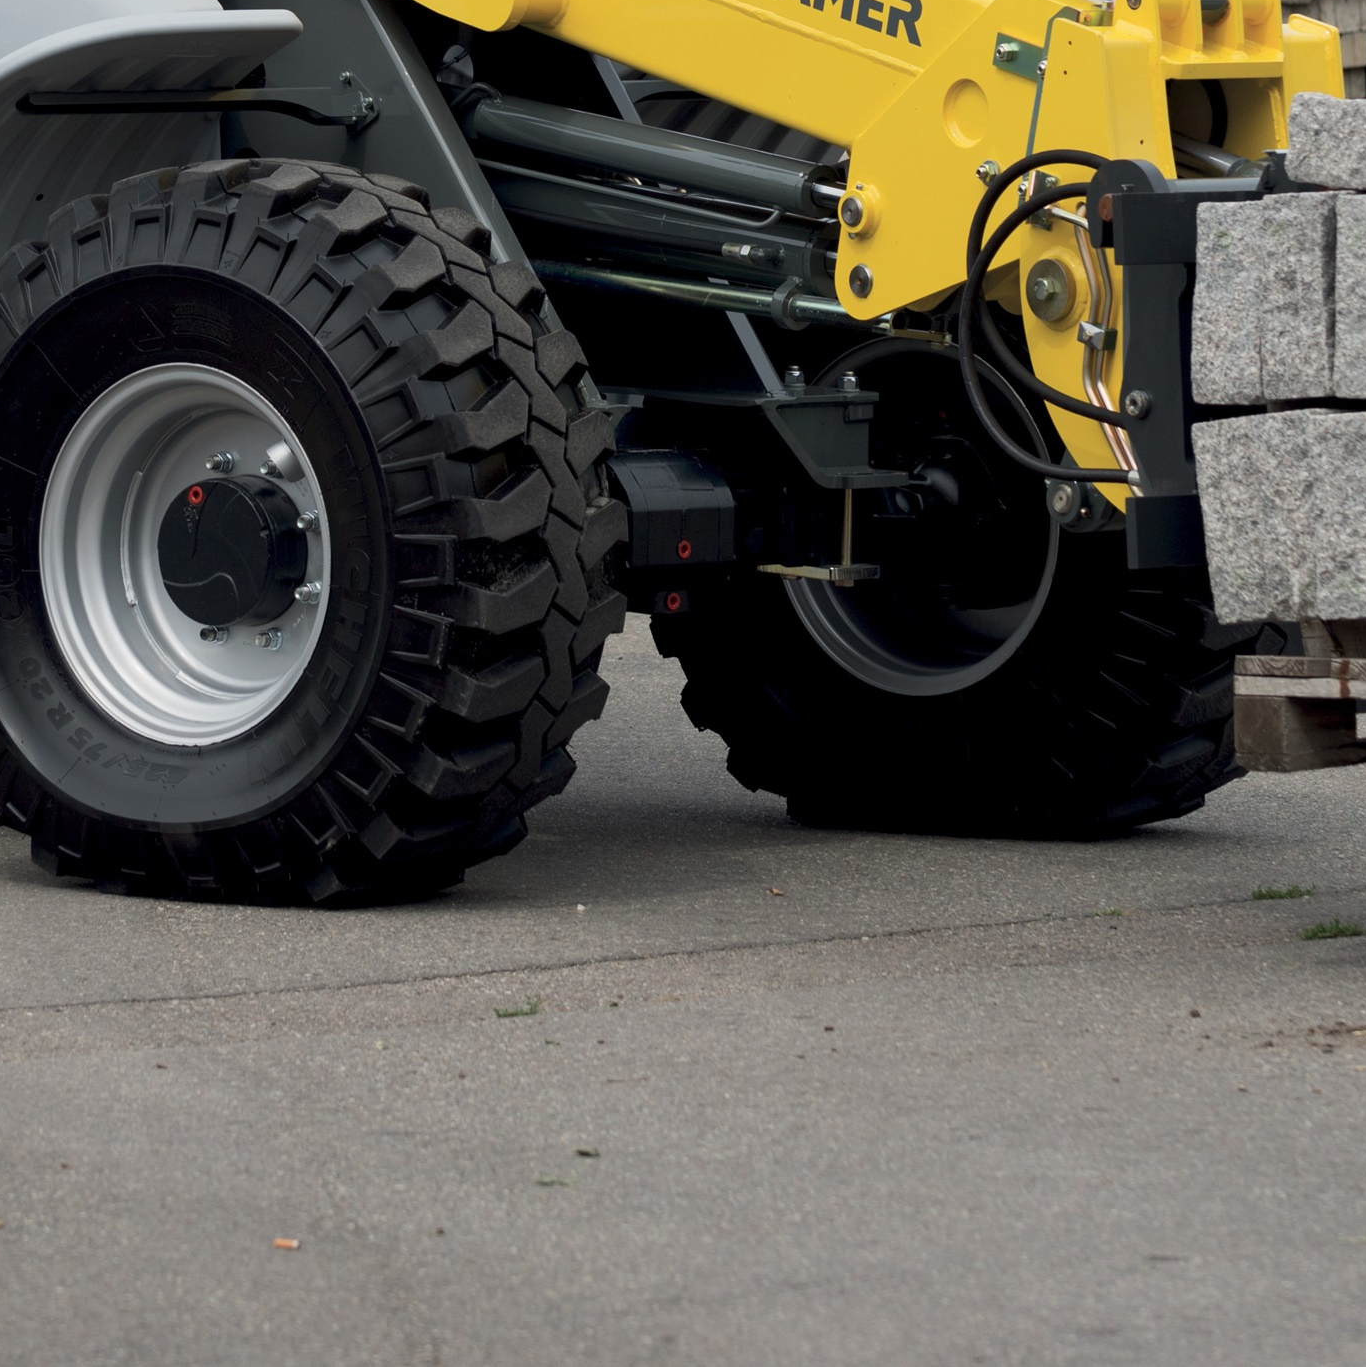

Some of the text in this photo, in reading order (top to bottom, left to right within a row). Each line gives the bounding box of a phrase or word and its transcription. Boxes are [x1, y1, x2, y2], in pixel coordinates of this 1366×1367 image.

[246, 443, 372, 786] MICHELIN
[18, 656, 55, 702] 20
[45, 700, 75, 731] R
